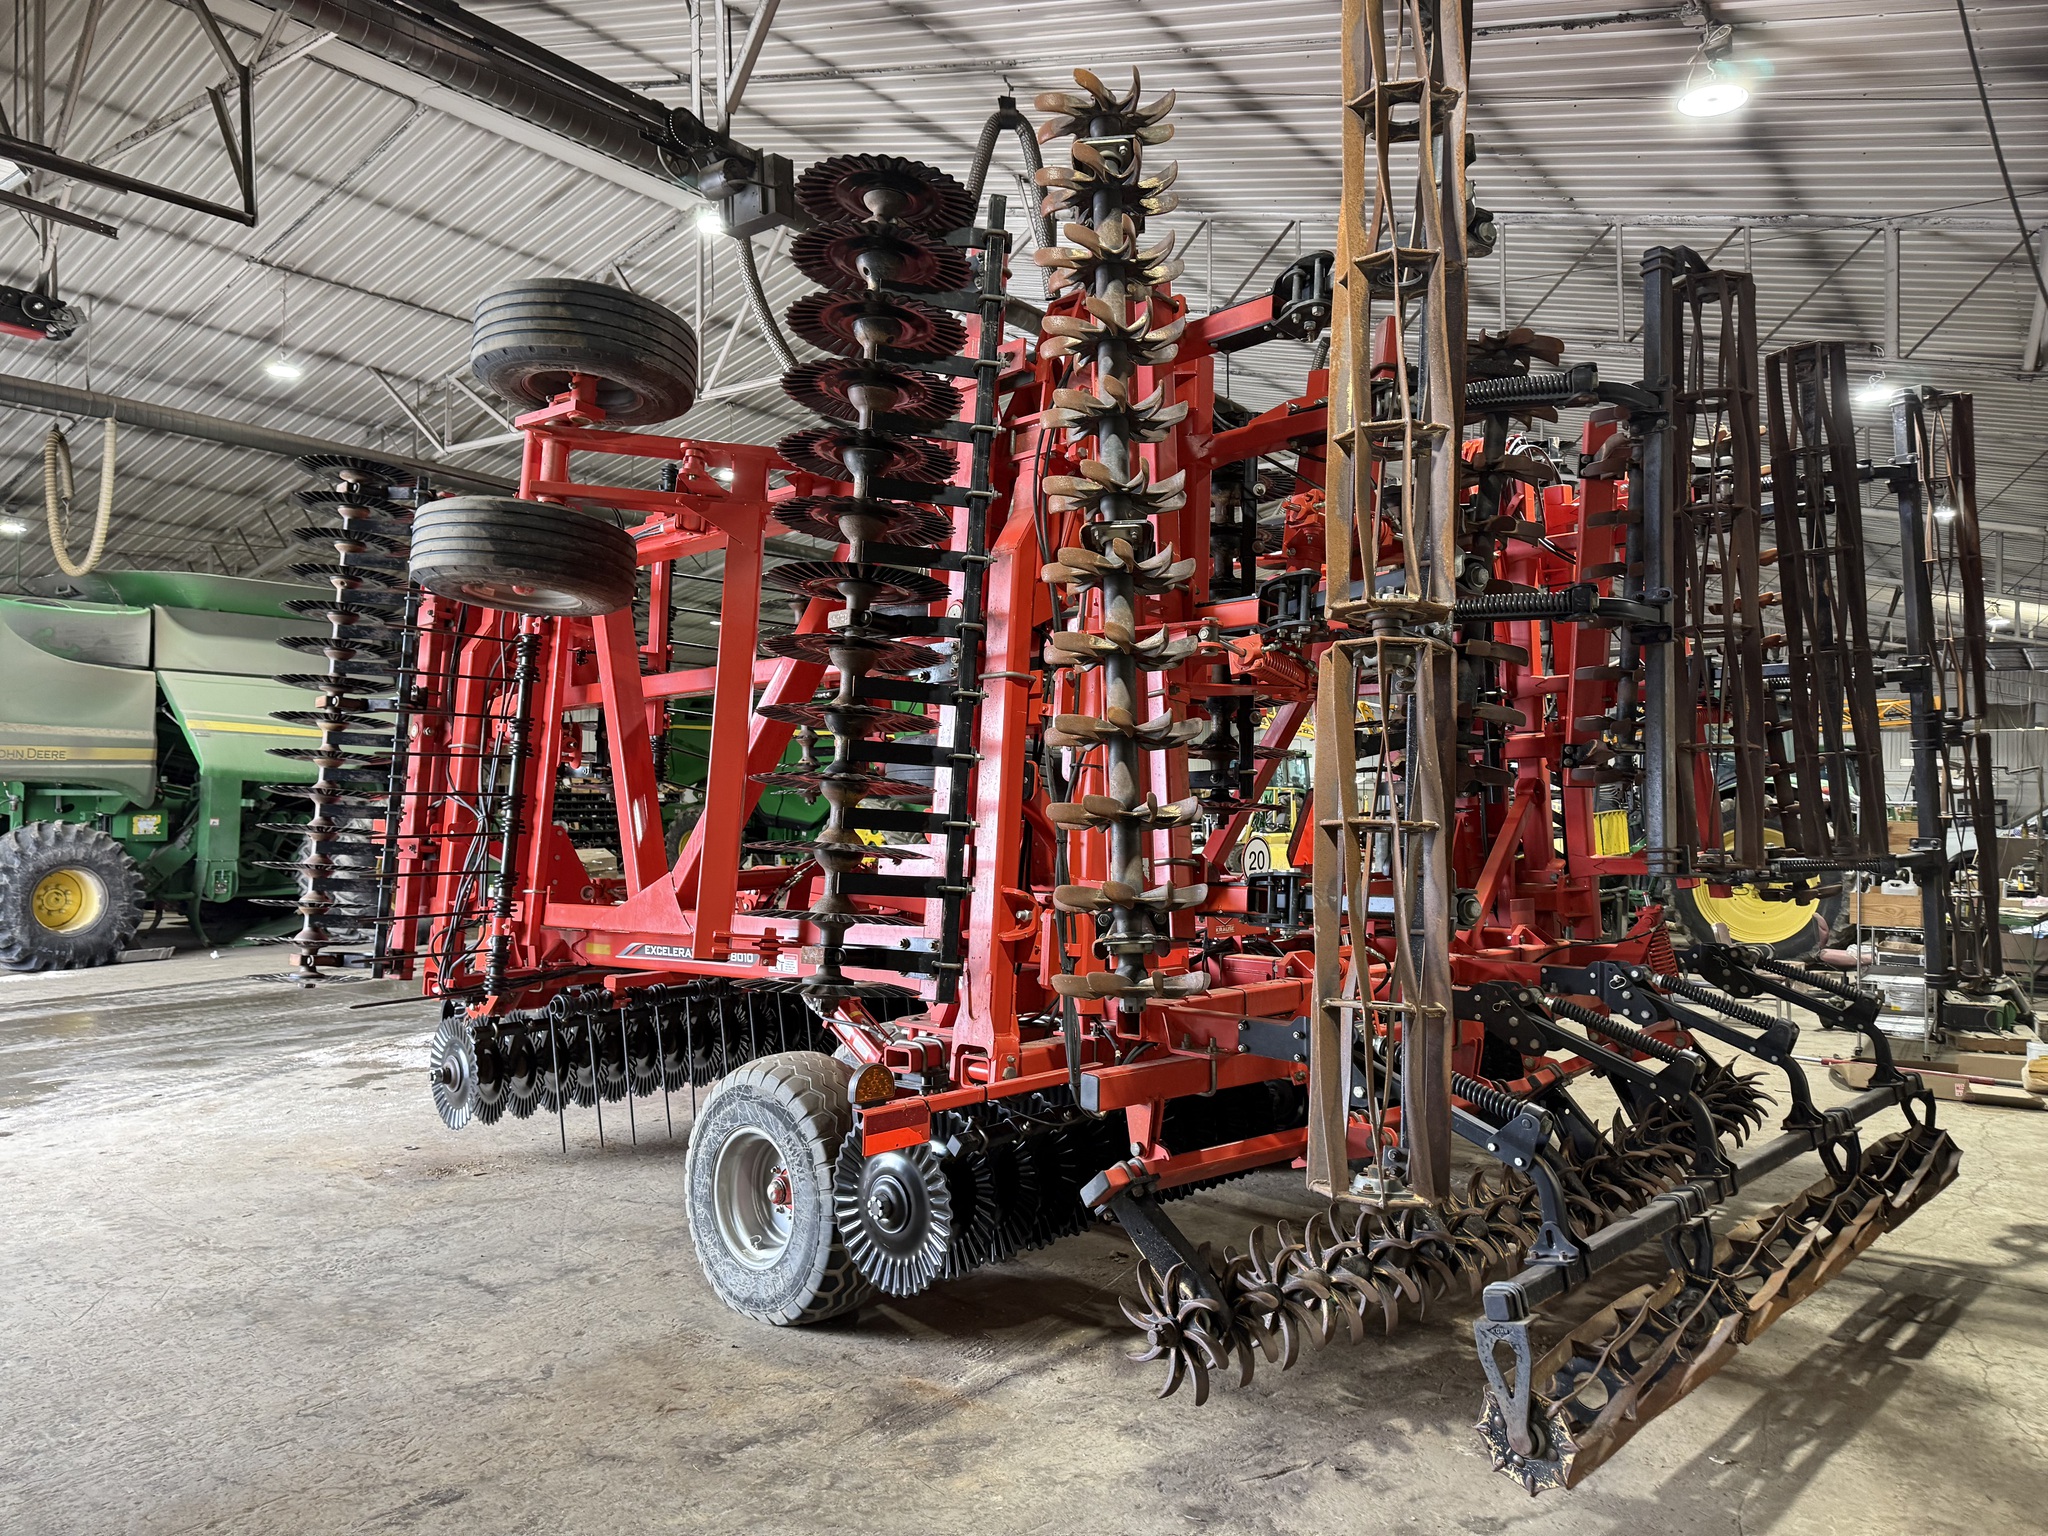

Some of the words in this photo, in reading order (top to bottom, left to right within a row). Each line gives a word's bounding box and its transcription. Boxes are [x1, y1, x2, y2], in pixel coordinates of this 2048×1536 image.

[27, 748, 67, 759] DEERE
[1249, 850, 1265, 870] 20
[645, 945, 693, 958] EXCELERA
[730, 952, 754, 963] 8010
